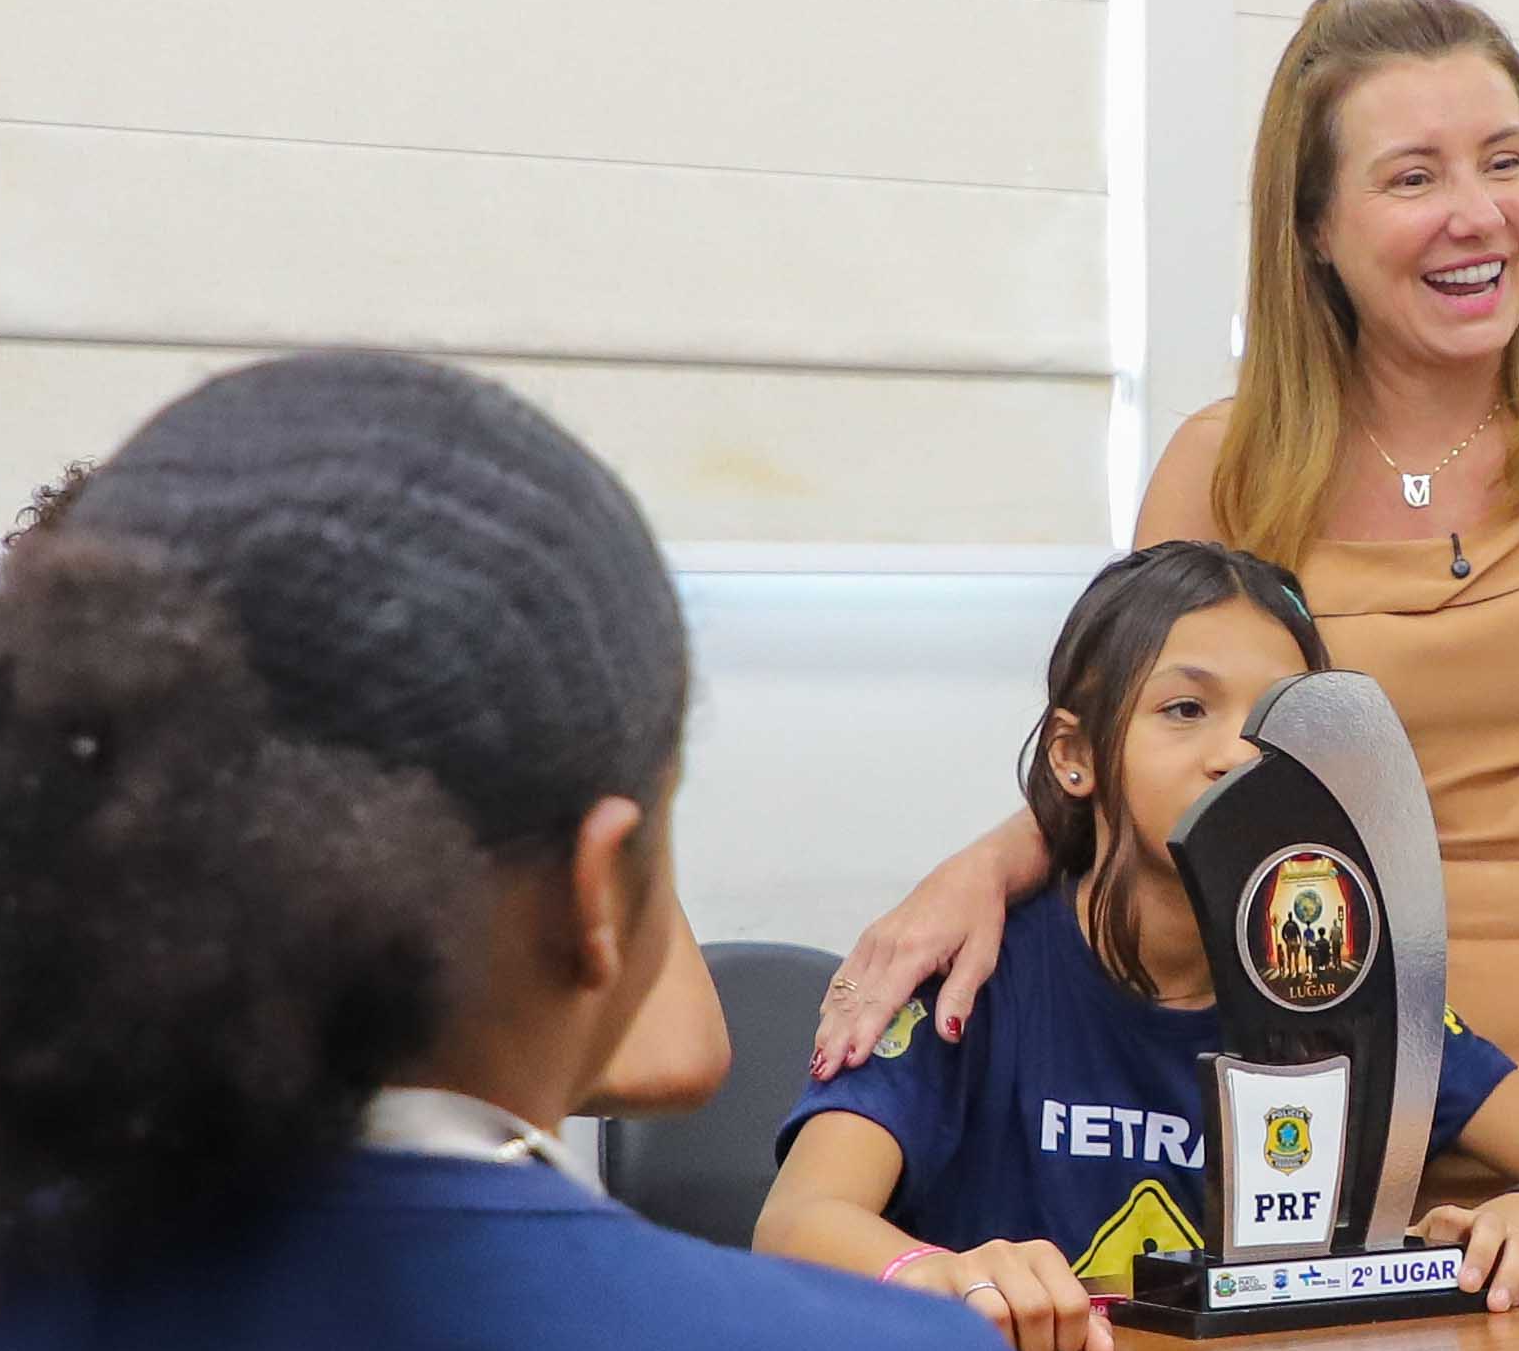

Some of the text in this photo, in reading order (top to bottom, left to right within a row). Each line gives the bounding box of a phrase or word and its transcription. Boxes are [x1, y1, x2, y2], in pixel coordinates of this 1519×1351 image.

[1289, 983, 1337, 999] LUGAR
[1254, 1191, 1321, 1223] PRF
[1380, 1260, 1456, 1285] LUGAR
